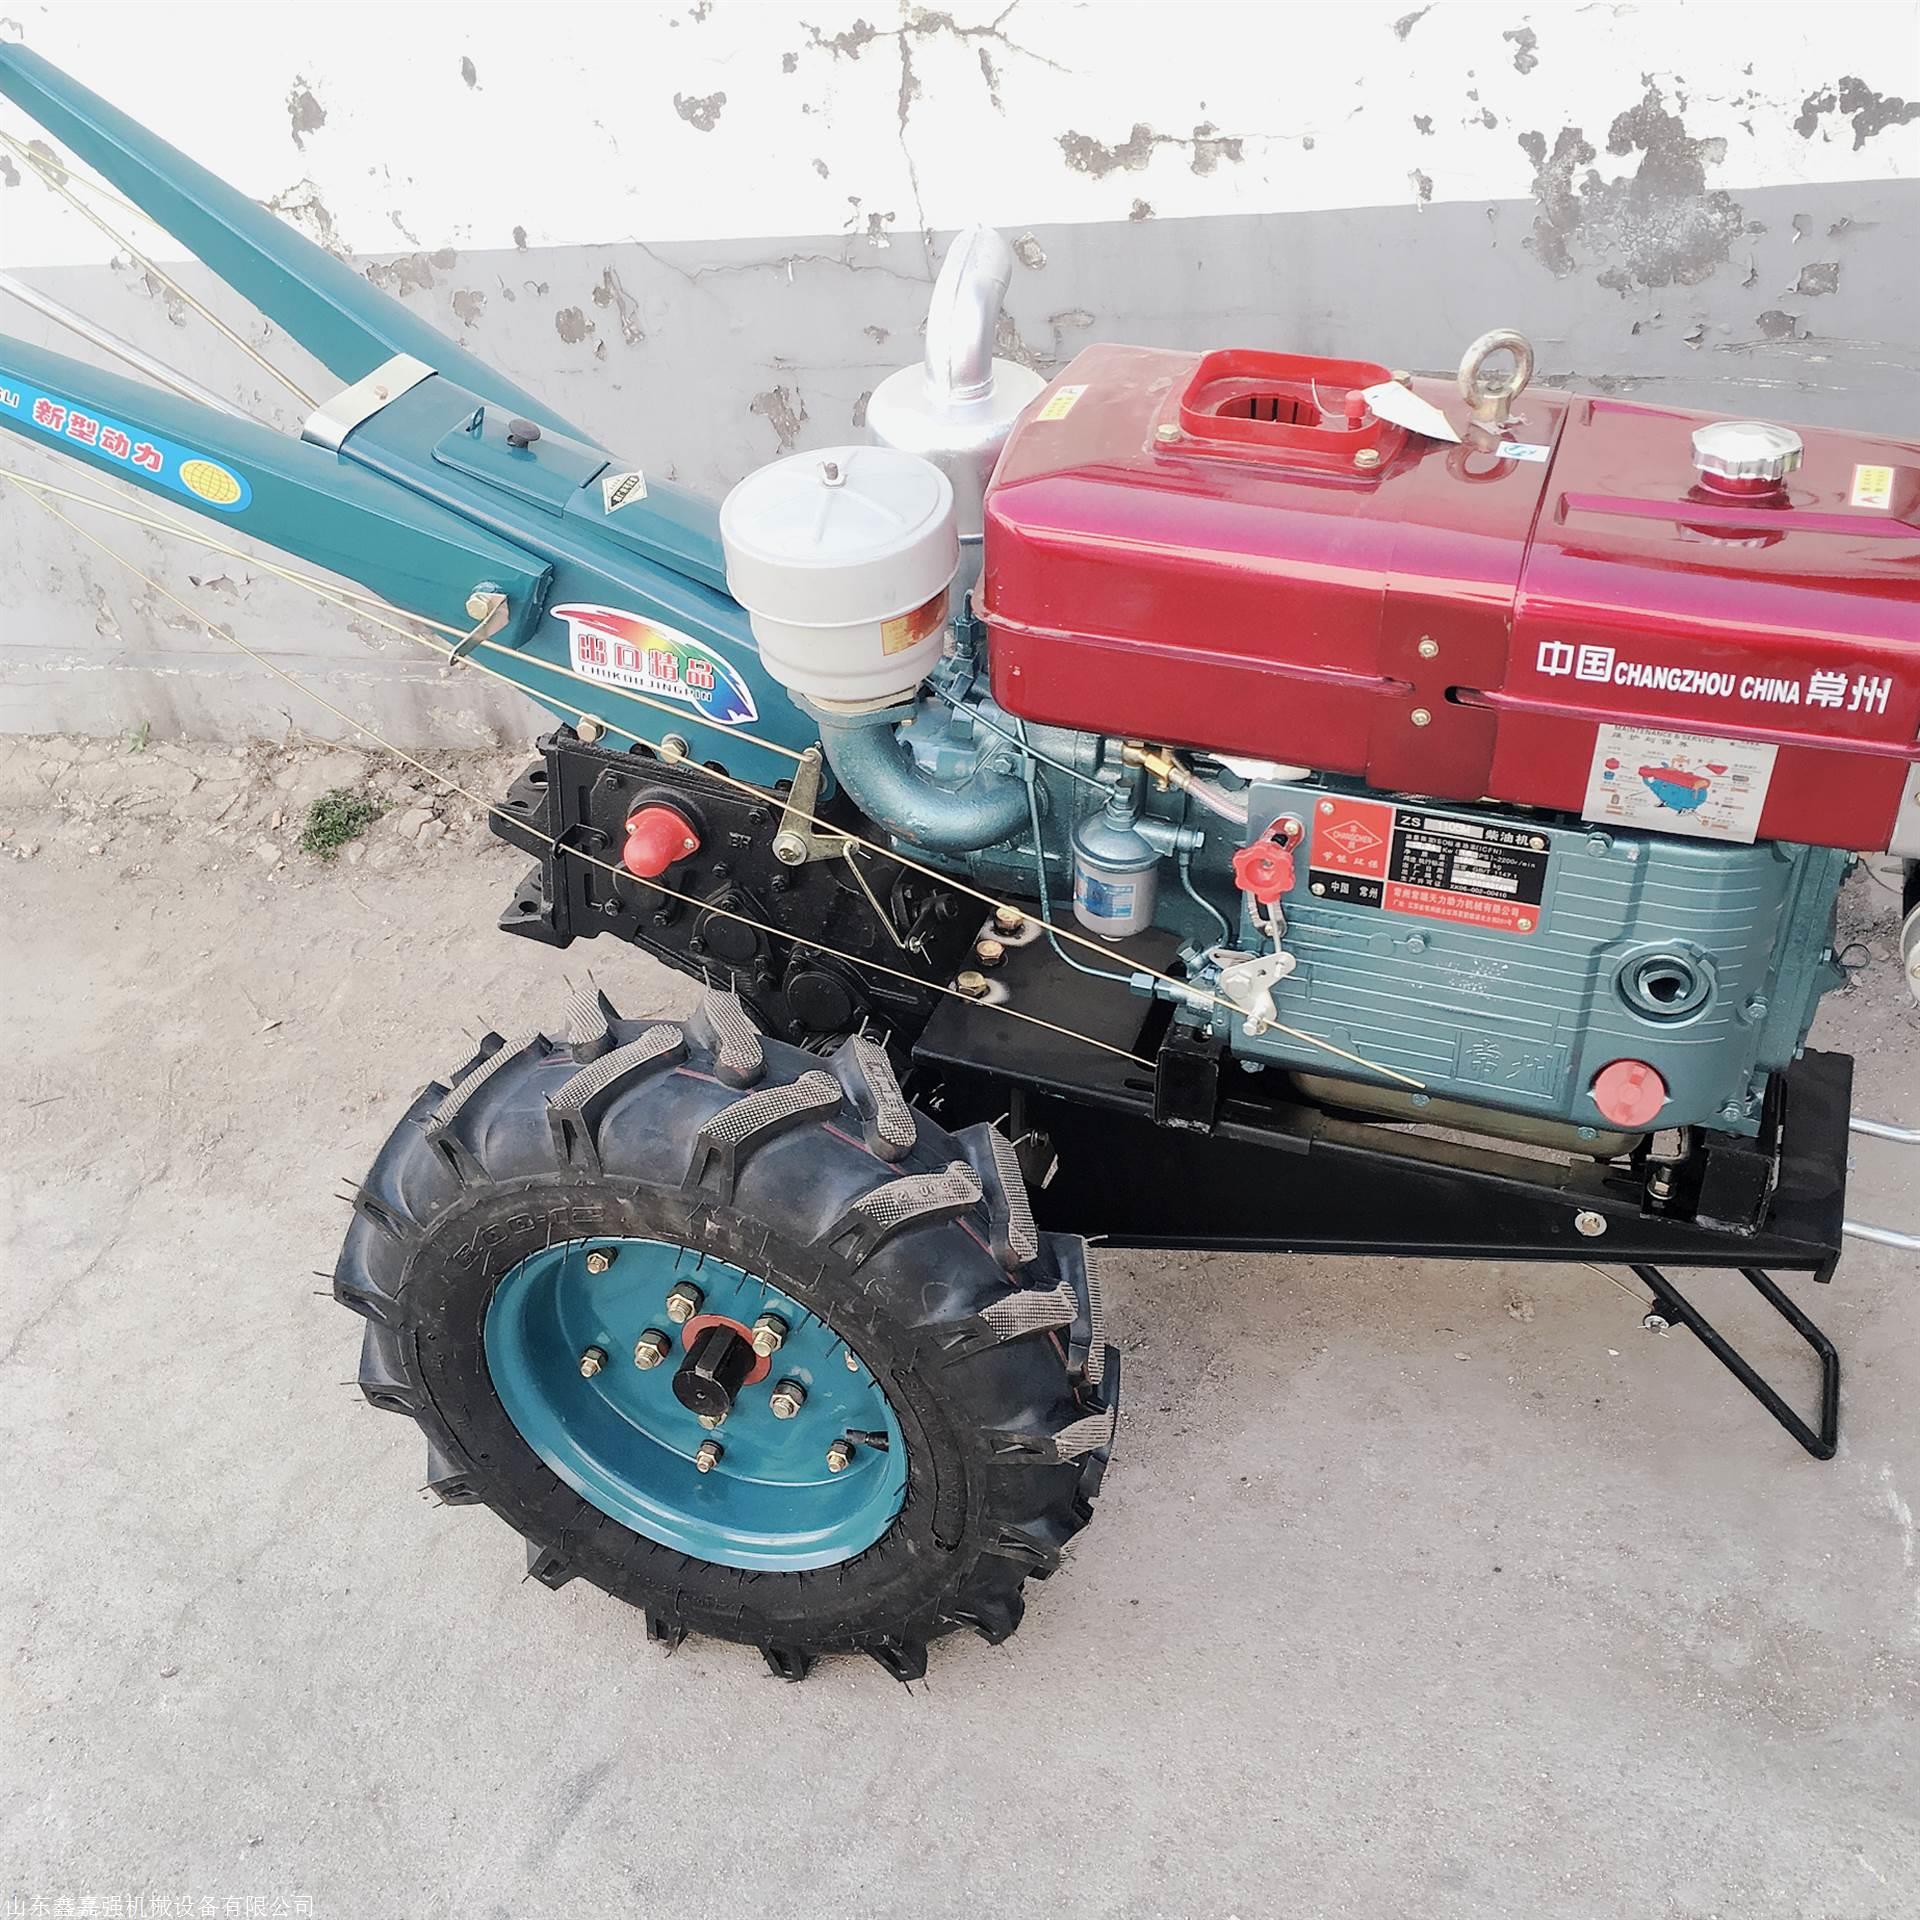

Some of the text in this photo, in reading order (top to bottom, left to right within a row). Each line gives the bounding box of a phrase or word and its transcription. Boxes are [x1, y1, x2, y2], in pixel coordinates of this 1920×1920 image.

[34, 400, 163, 471] 新型动力
[578, 634, 715, 690] 出口精品
[1536, 641, 1894, 715] 中国 CHANGZHOU CHINA 常州
[1400, 815, 1421, 828] ZS
[1485, 829, 1529, 846] 柴油机
[1331, 880, 1378, 899] 中国 常州
[1465, 1039, 1554, 1090] 常州
